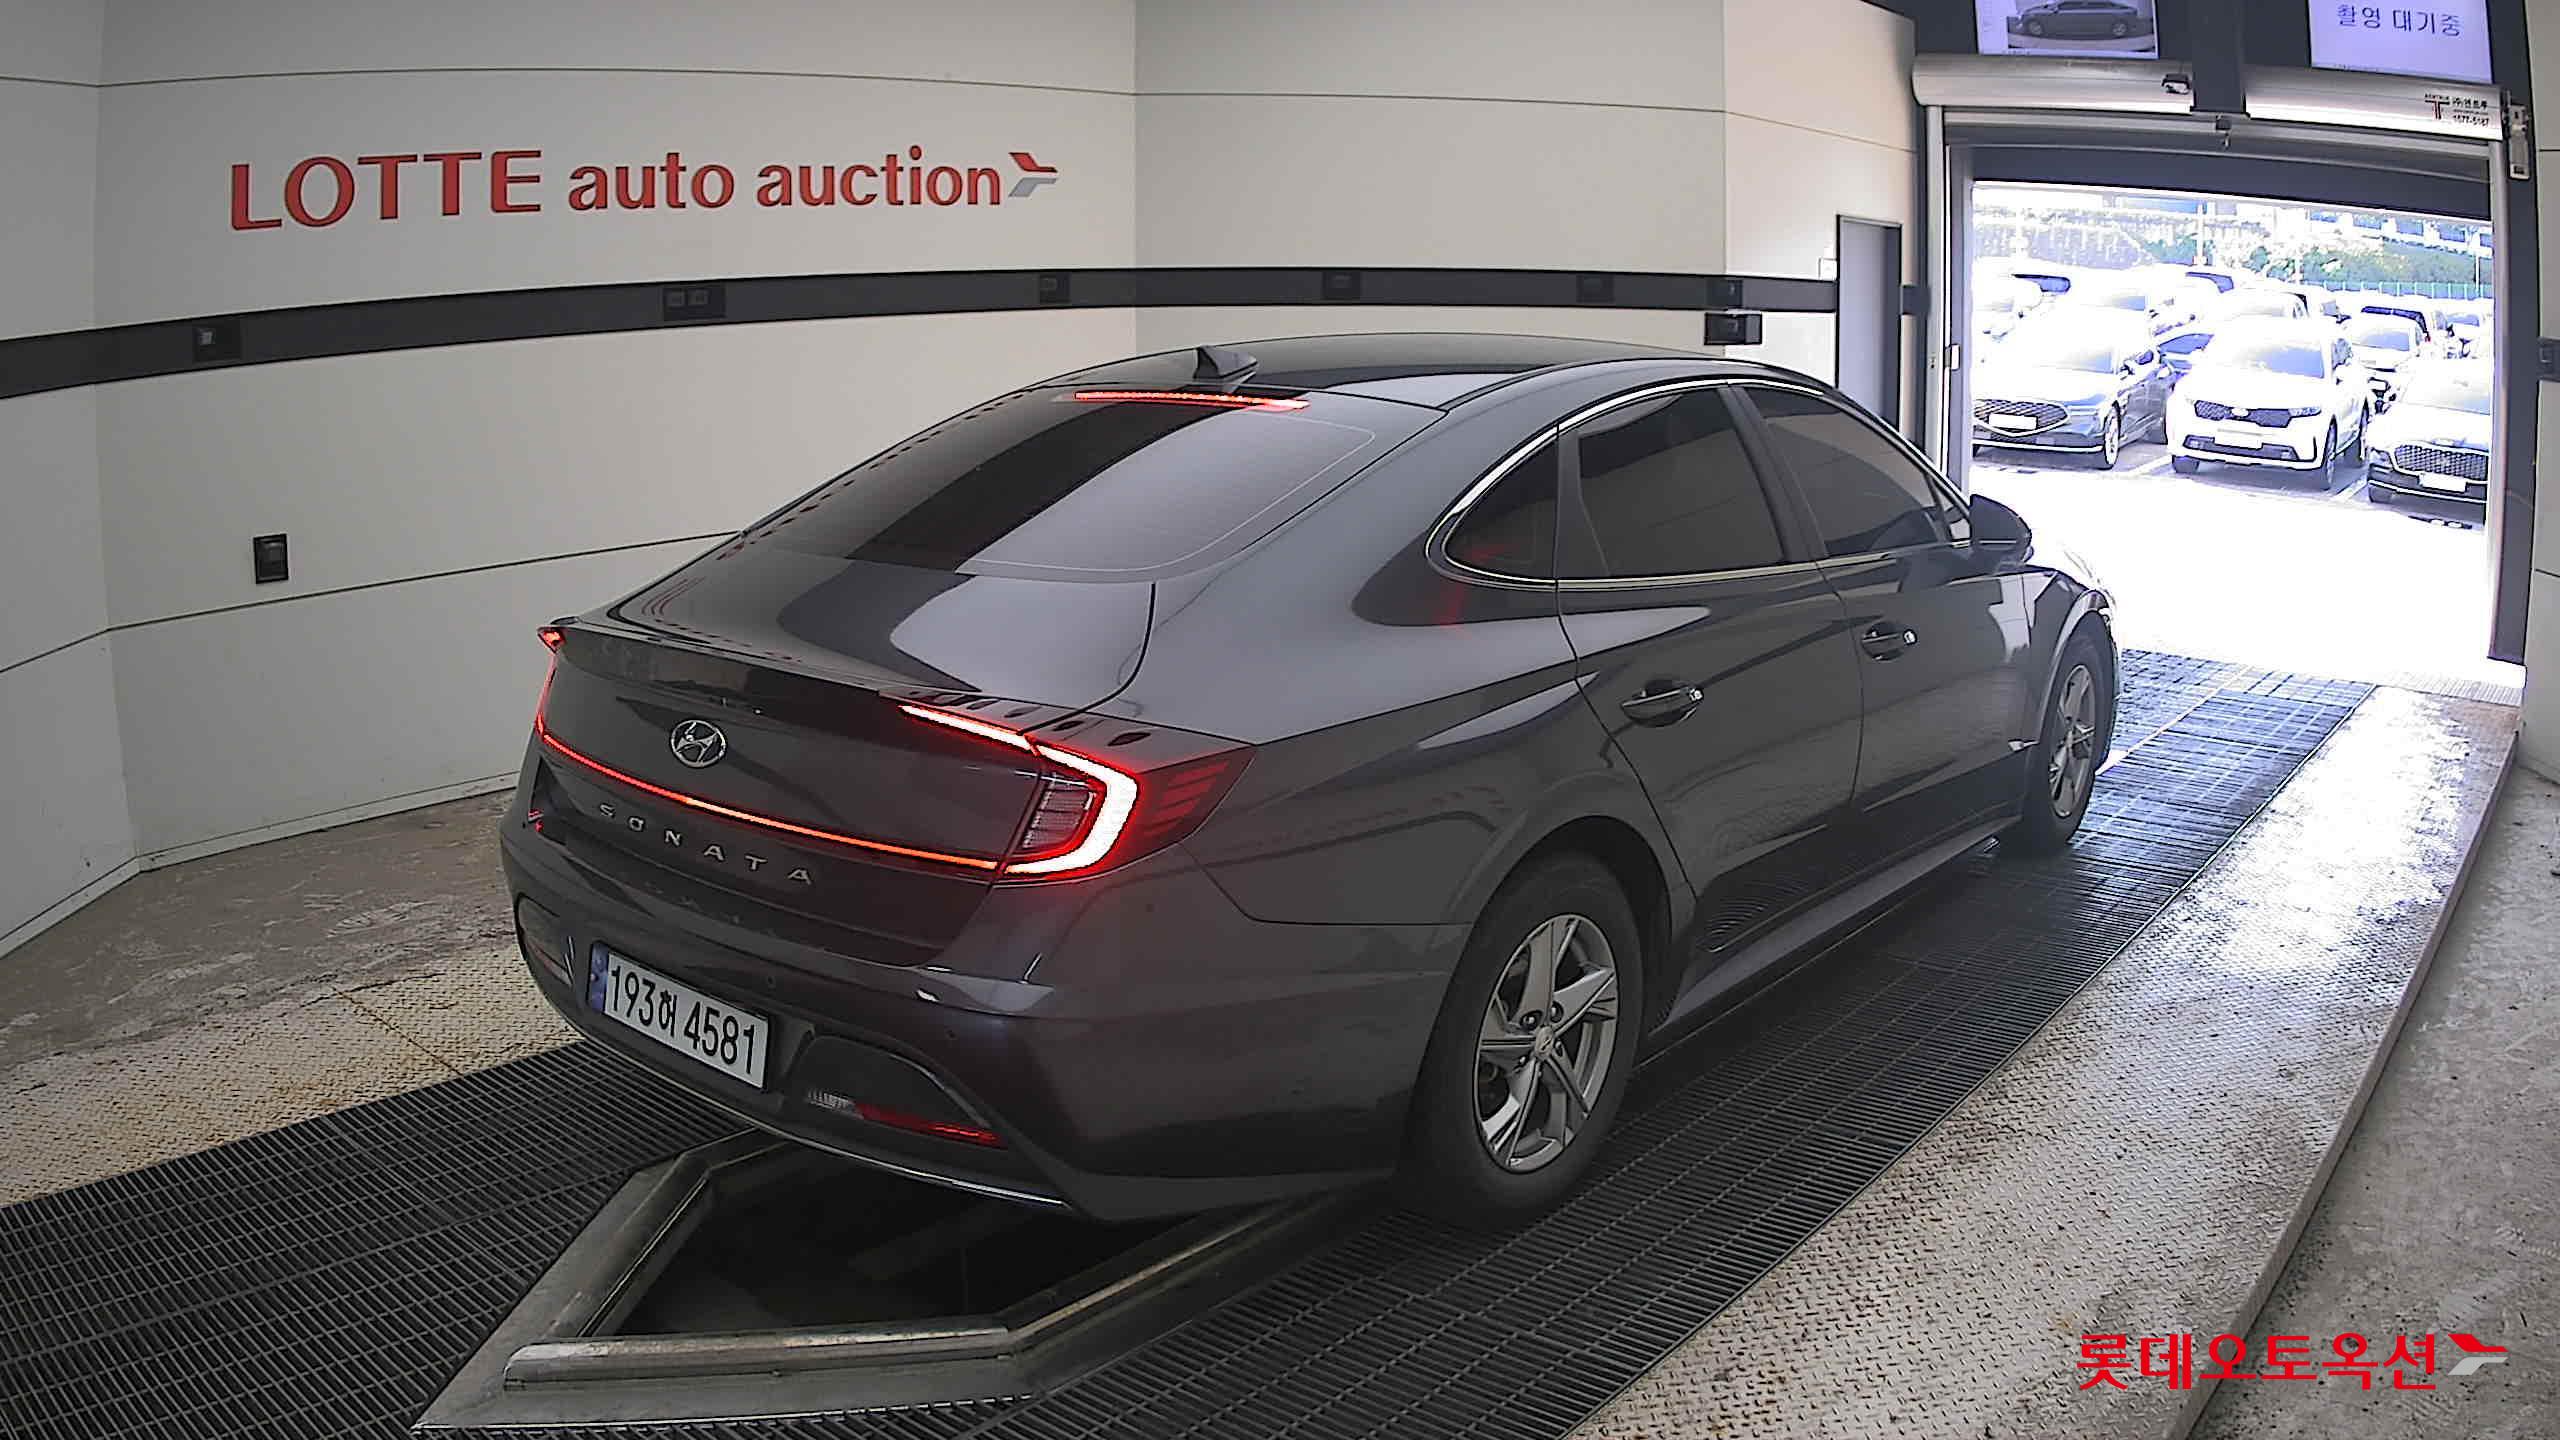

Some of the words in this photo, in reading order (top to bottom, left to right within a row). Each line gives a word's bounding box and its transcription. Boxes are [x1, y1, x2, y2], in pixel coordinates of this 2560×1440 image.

[2337, 4, 2381, 29] 촬영
[2392, 9, 2461, 37] 대기중
[231, 150, 541, 231] LOTTE
[568, 152, 736, 210] auto
[756, 145, 1002, 208] auction
[600, 803, 813, 886] SONATA
[610, 965, 678, 1039] 193허
[683, 1000, 756, 1075] 4581
